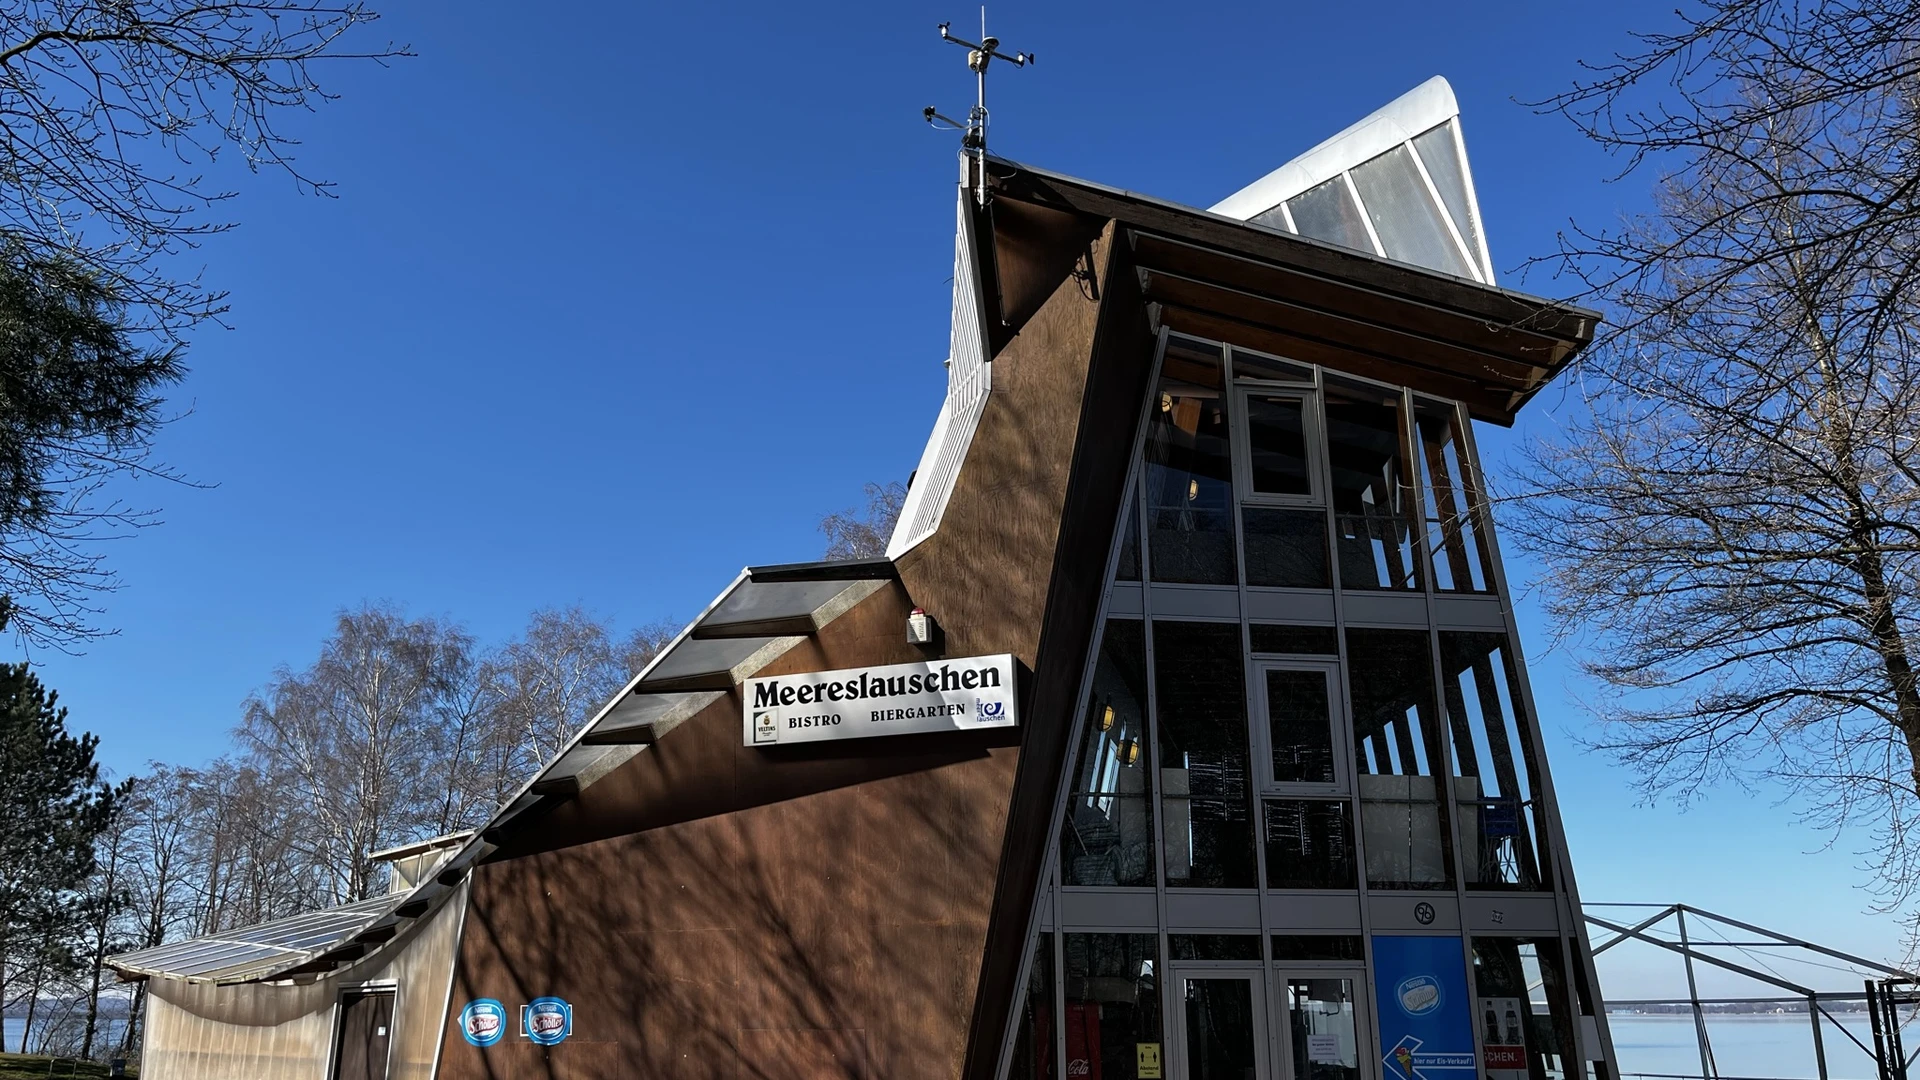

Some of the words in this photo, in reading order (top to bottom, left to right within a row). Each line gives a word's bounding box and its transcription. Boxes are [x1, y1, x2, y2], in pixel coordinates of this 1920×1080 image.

[753, 665, 1001, 708] Meereslauschen
[788, 714, 841, 728] BISTRO
[870, 703, 965, 722] BIERGARTEN
[1418, 905, 1432, 921] 96
[469, 1018, 499, 1034] Schöller
[533, 1017, 563, 1033] Schöller
[1068, 1059, 1089, 1075] Cola
[1413, 1057, 1425, 1065] hier
[1436, 1057, 1472, 1065] Eis-Verkauf!
